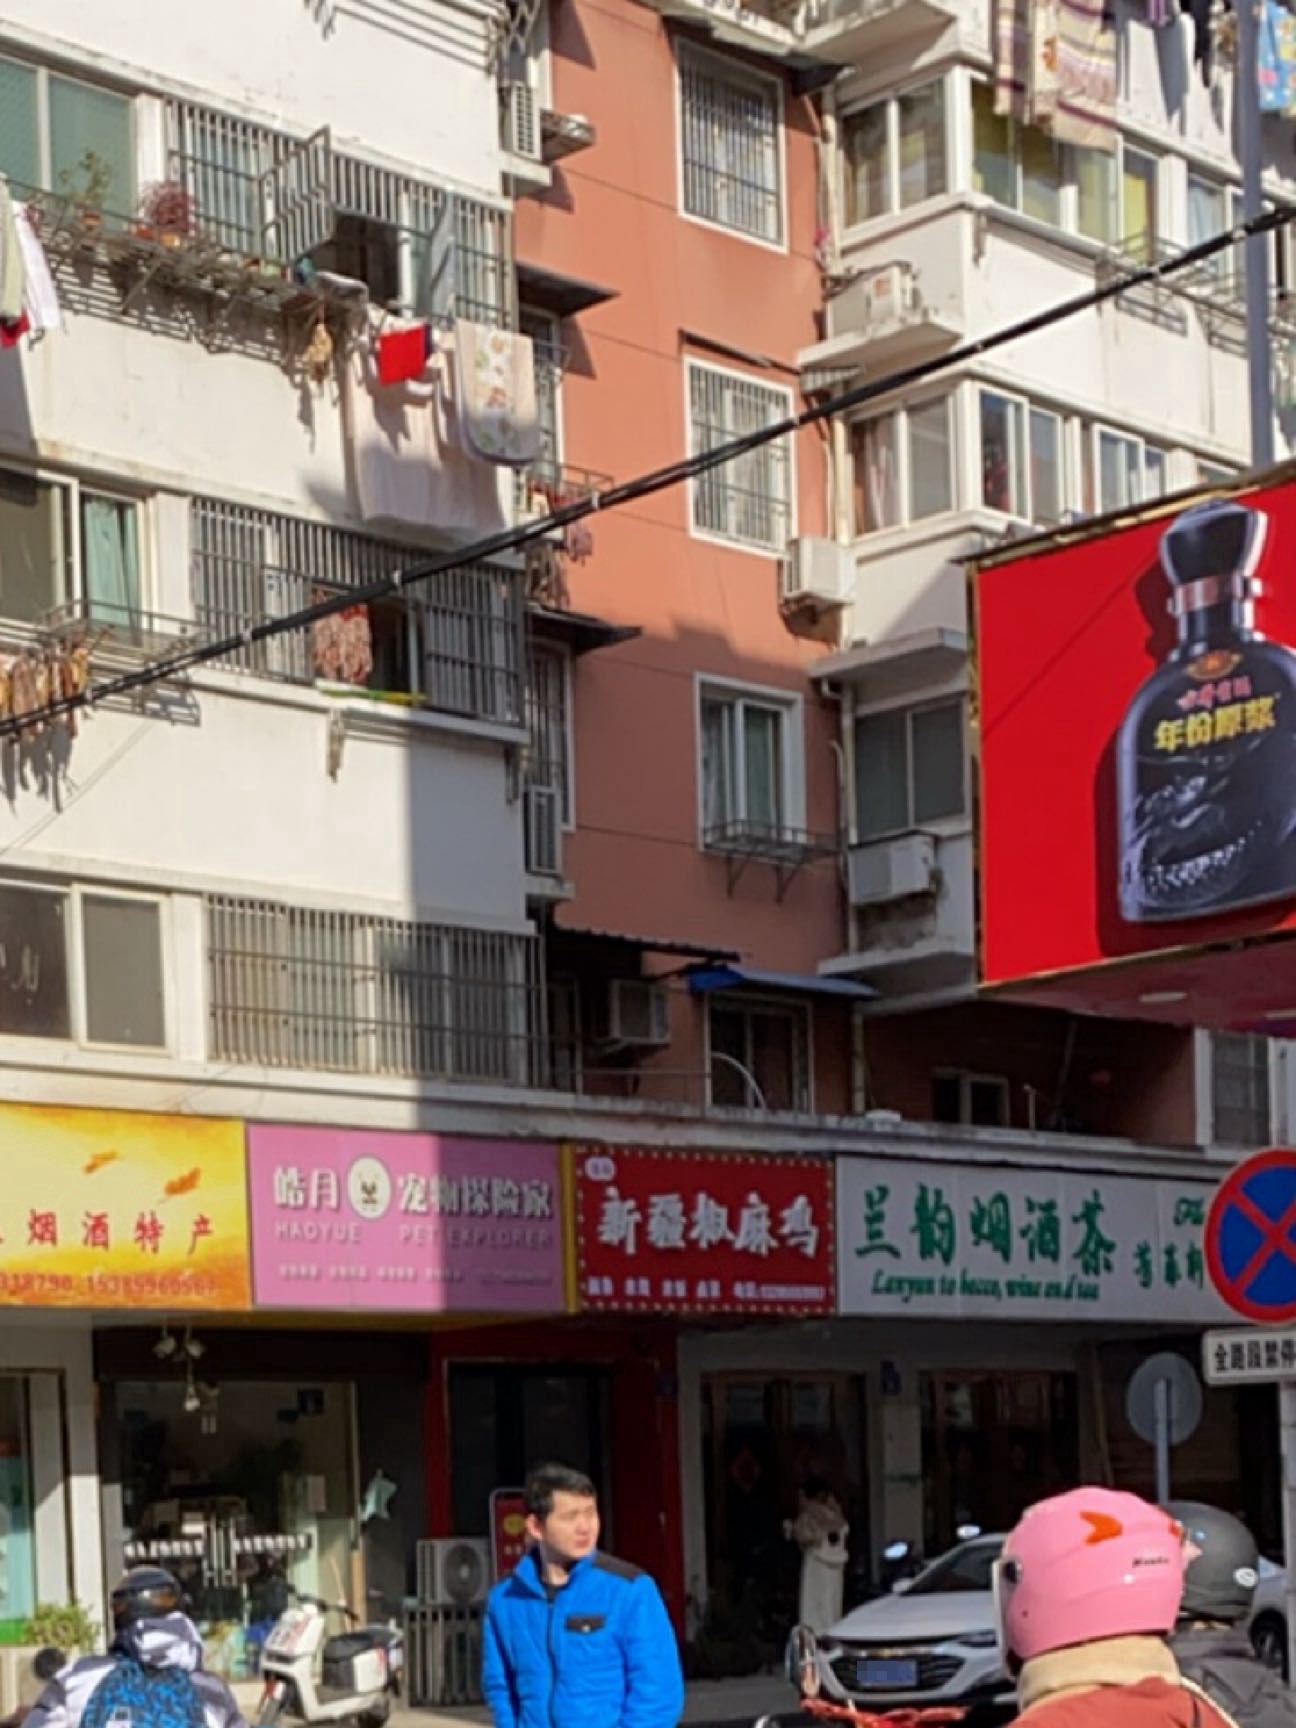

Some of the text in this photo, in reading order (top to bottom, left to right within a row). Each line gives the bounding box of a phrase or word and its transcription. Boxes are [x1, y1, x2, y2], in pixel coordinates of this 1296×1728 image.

[273, 1165, 340, 1209] 皓月
[274, 1221, 552, 1250] HAOYUE PET EXPLORER
[598, 1185, 820, 1258] 新疆椒麻鸡
[855, 1183, 1116, 1276] 兰韵烟酒茶
